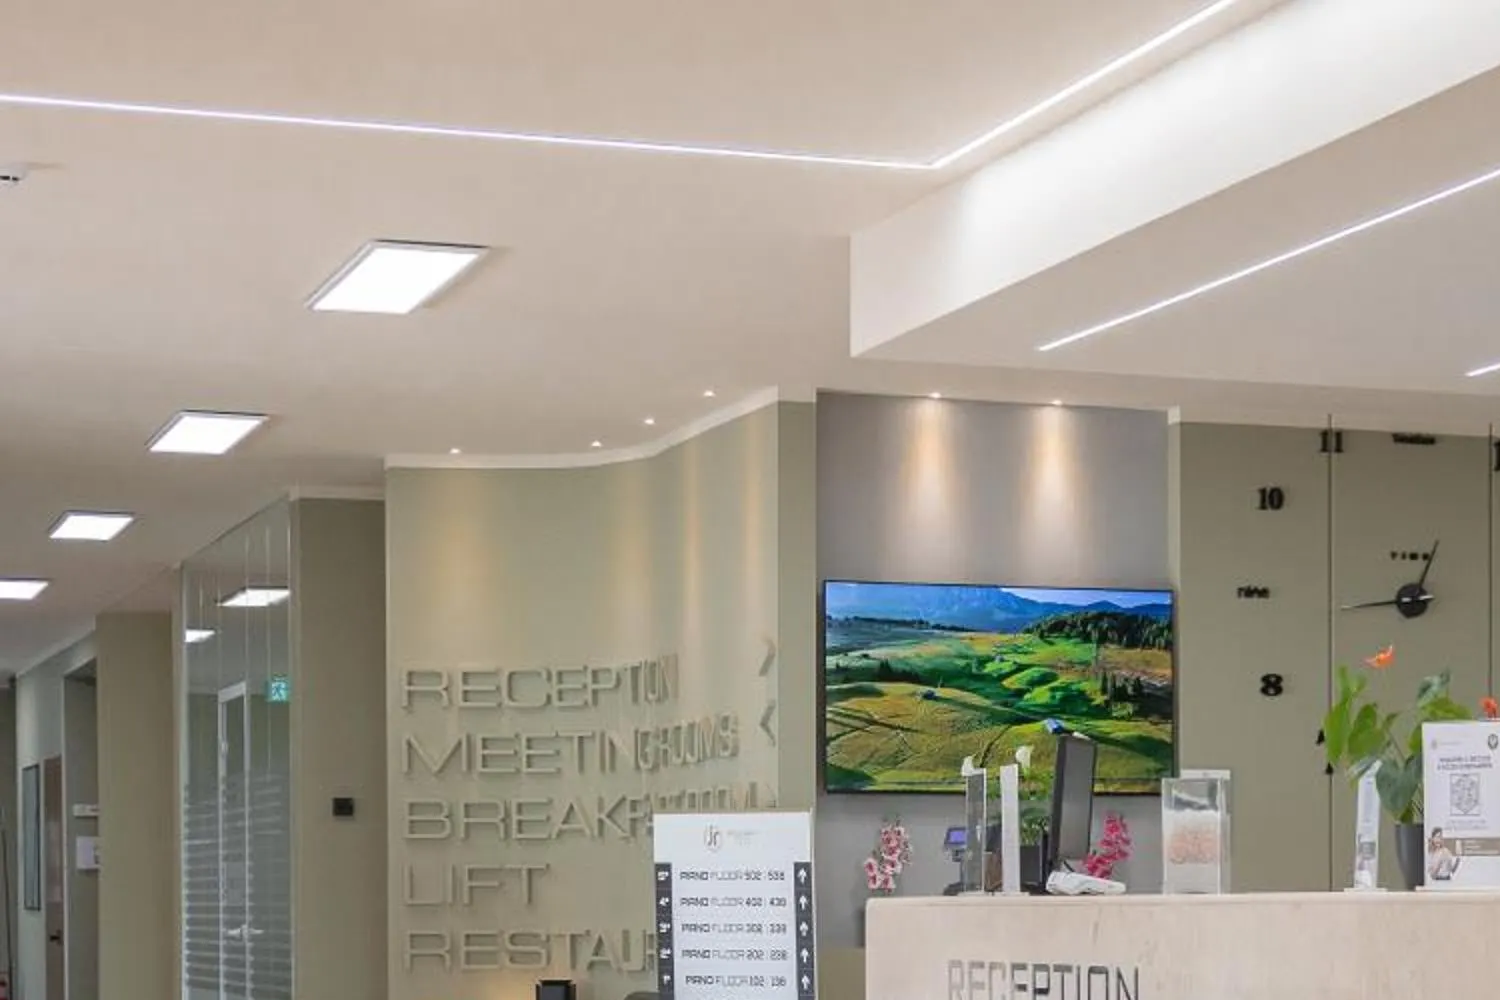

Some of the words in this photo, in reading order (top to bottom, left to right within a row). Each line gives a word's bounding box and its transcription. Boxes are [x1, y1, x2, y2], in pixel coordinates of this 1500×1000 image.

[1319, 430, 1344, 453] 11
[1257, 487, 1284, 510] 10
[402, 654, 679, 711] RECEPTION
[1260, 674, 1284, 696] 8
[404, 731, 661, 775] MEETING
[404, 864, 550, 907] LIFT
[680, 871, 708, 881] PIANO
[710, 871, 742, 881] FLOOR
[680, 897, 709, 907] PIANO
[710, 897, 743, 907] FLOOR
[681, 923, 710, 933] PIANO
[712, 923, 744, 933] FLOOR
[681, 949, 711, 959] PIANO
[712, 949, 745, 959] FLOOR
[685, 975, 714, 985] PIANO
[715, 975, 748, 987] FLOOR
